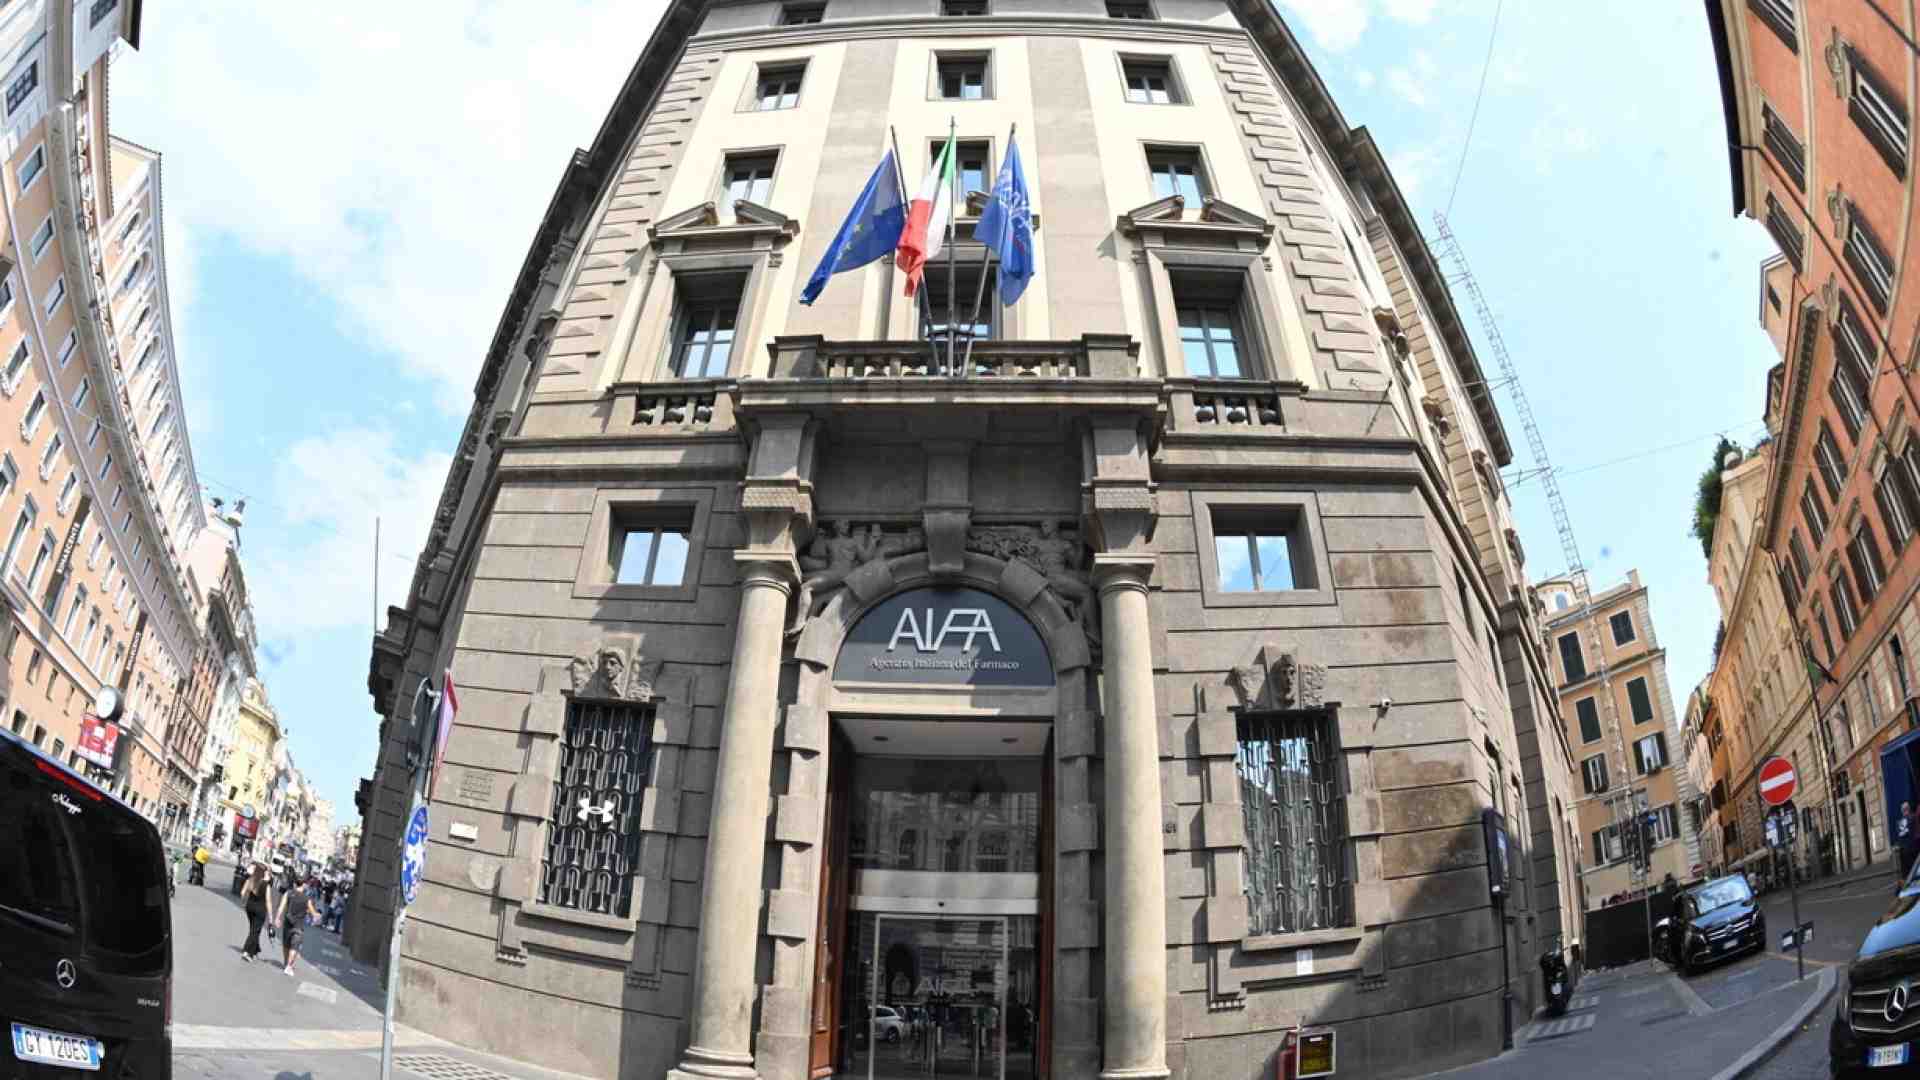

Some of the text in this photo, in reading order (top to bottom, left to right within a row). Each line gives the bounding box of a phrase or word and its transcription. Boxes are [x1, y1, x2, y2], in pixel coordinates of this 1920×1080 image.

[887, 607, 1001, 651] AIFA
[870, 656, 1020, 671] Agenzia Italiana del Farmaco
